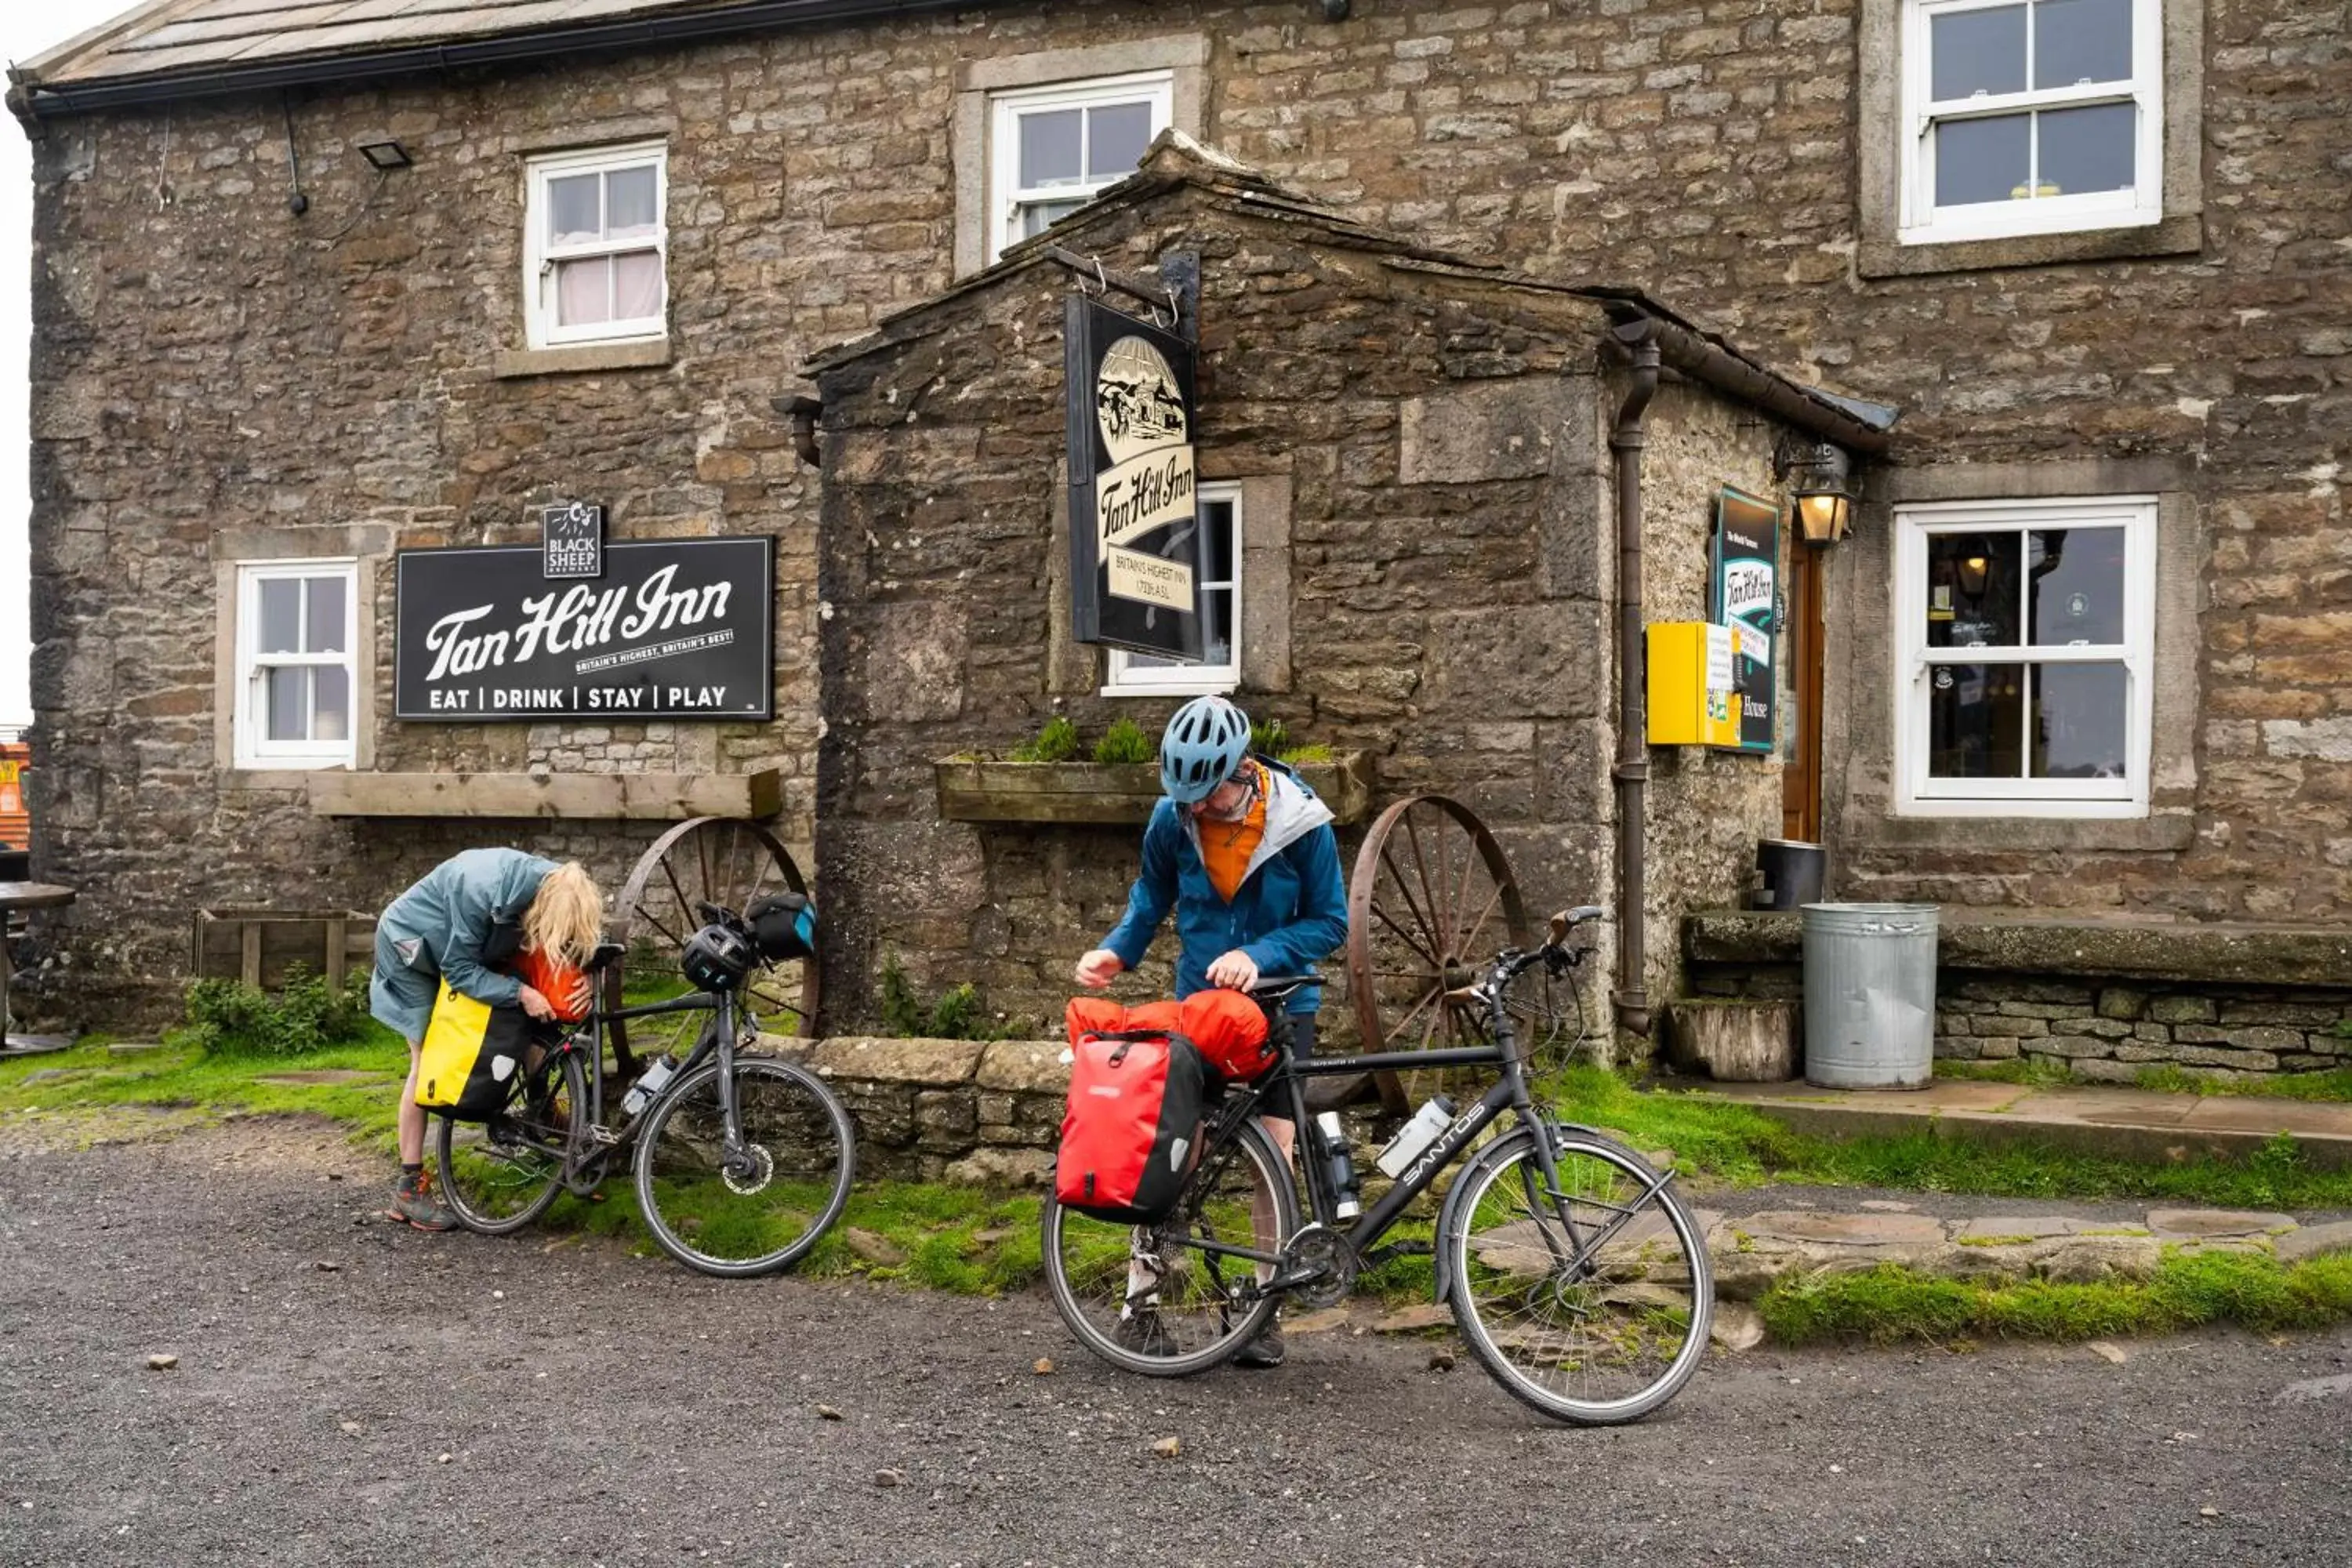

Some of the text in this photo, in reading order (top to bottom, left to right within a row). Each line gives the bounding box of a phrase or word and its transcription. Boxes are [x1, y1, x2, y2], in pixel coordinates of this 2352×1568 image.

[1101, 454, 1192, 539] Tan Hill Inn
[550, 537, 595, 553] BLACK
[550, 551, 595, 567] SHEEP
[426, 564, 731, 681] Tan Hill Inn
[575, 656, 618, 672] BRITAIN'S
[662, 638, 705, 654] BRITAIN'S
[430, 686, 726, 709] EAT DRINK STAY PLAY
[1743, 695, 1768, 719] House
[1403, 1102, 1486, 1186] SANTOS
